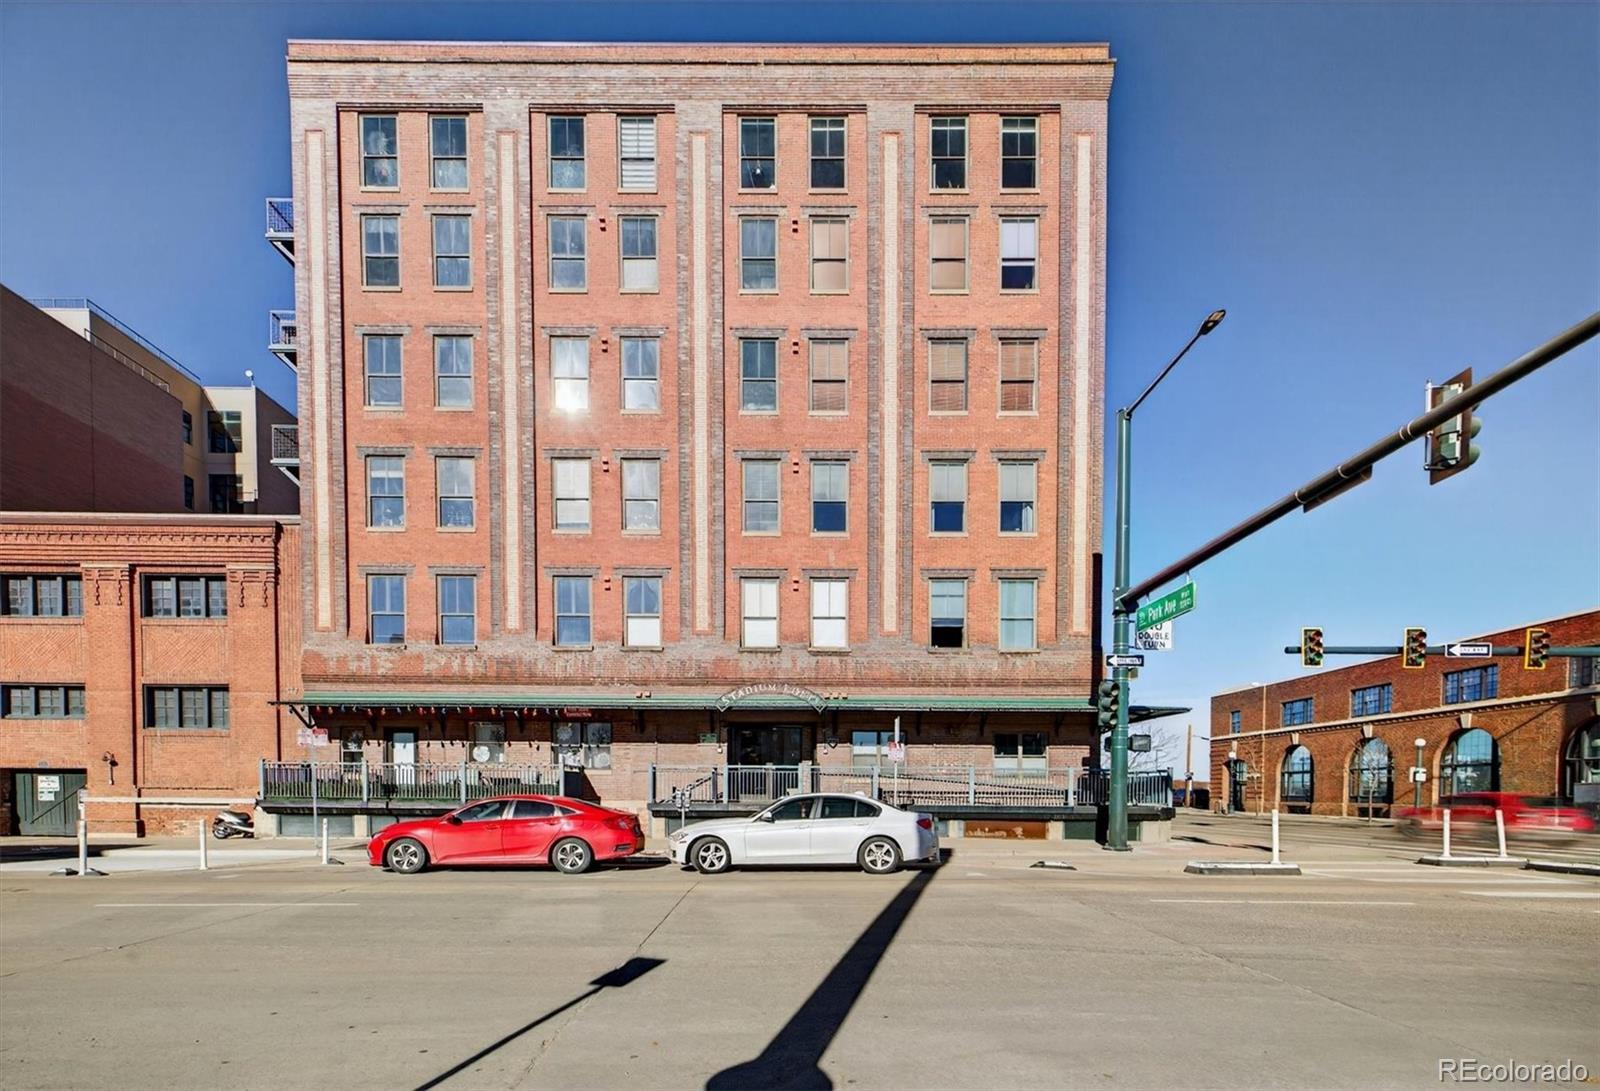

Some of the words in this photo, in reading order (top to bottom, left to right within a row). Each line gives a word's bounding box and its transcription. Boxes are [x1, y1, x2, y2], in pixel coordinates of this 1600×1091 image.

[1148, 604, 1163, 623] Park
[1164, 599, 1177, 614] Ave
[1138, 632, 1170, 641] DOUBLE
[1143, 640, 1166, 648] TURN
[720, 683, 777, 706] STADIUM
